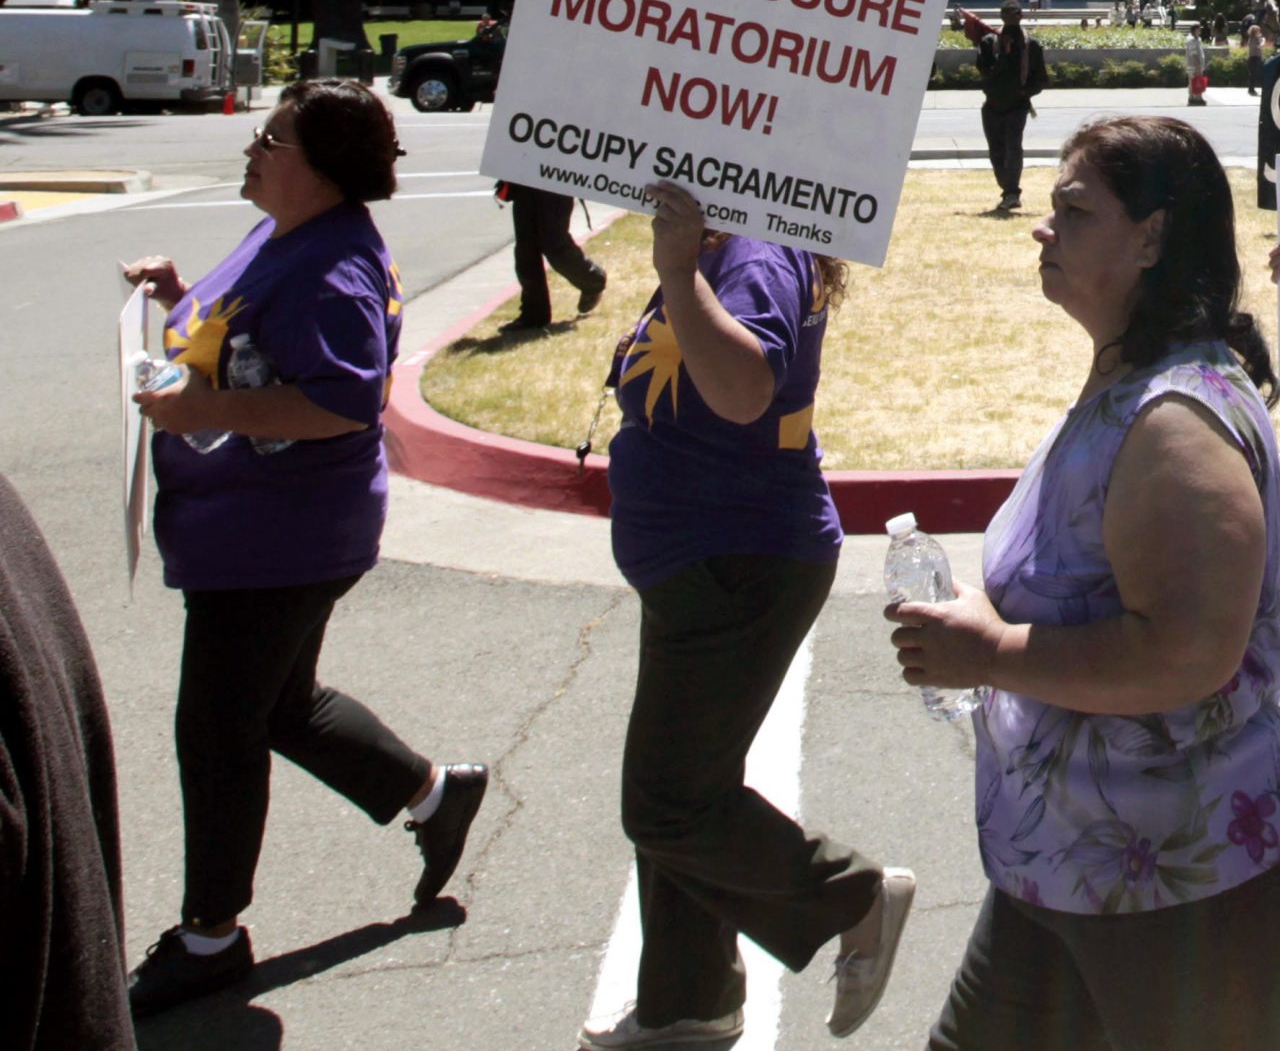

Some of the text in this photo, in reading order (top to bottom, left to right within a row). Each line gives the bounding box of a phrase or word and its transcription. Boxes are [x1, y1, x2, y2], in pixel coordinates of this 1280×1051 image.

[641, 67, 779, 135] NOW!
[508, 113, 878, 224] OCCUPY SACRAMENTO
[766, 213, 832, 245] Thanks
